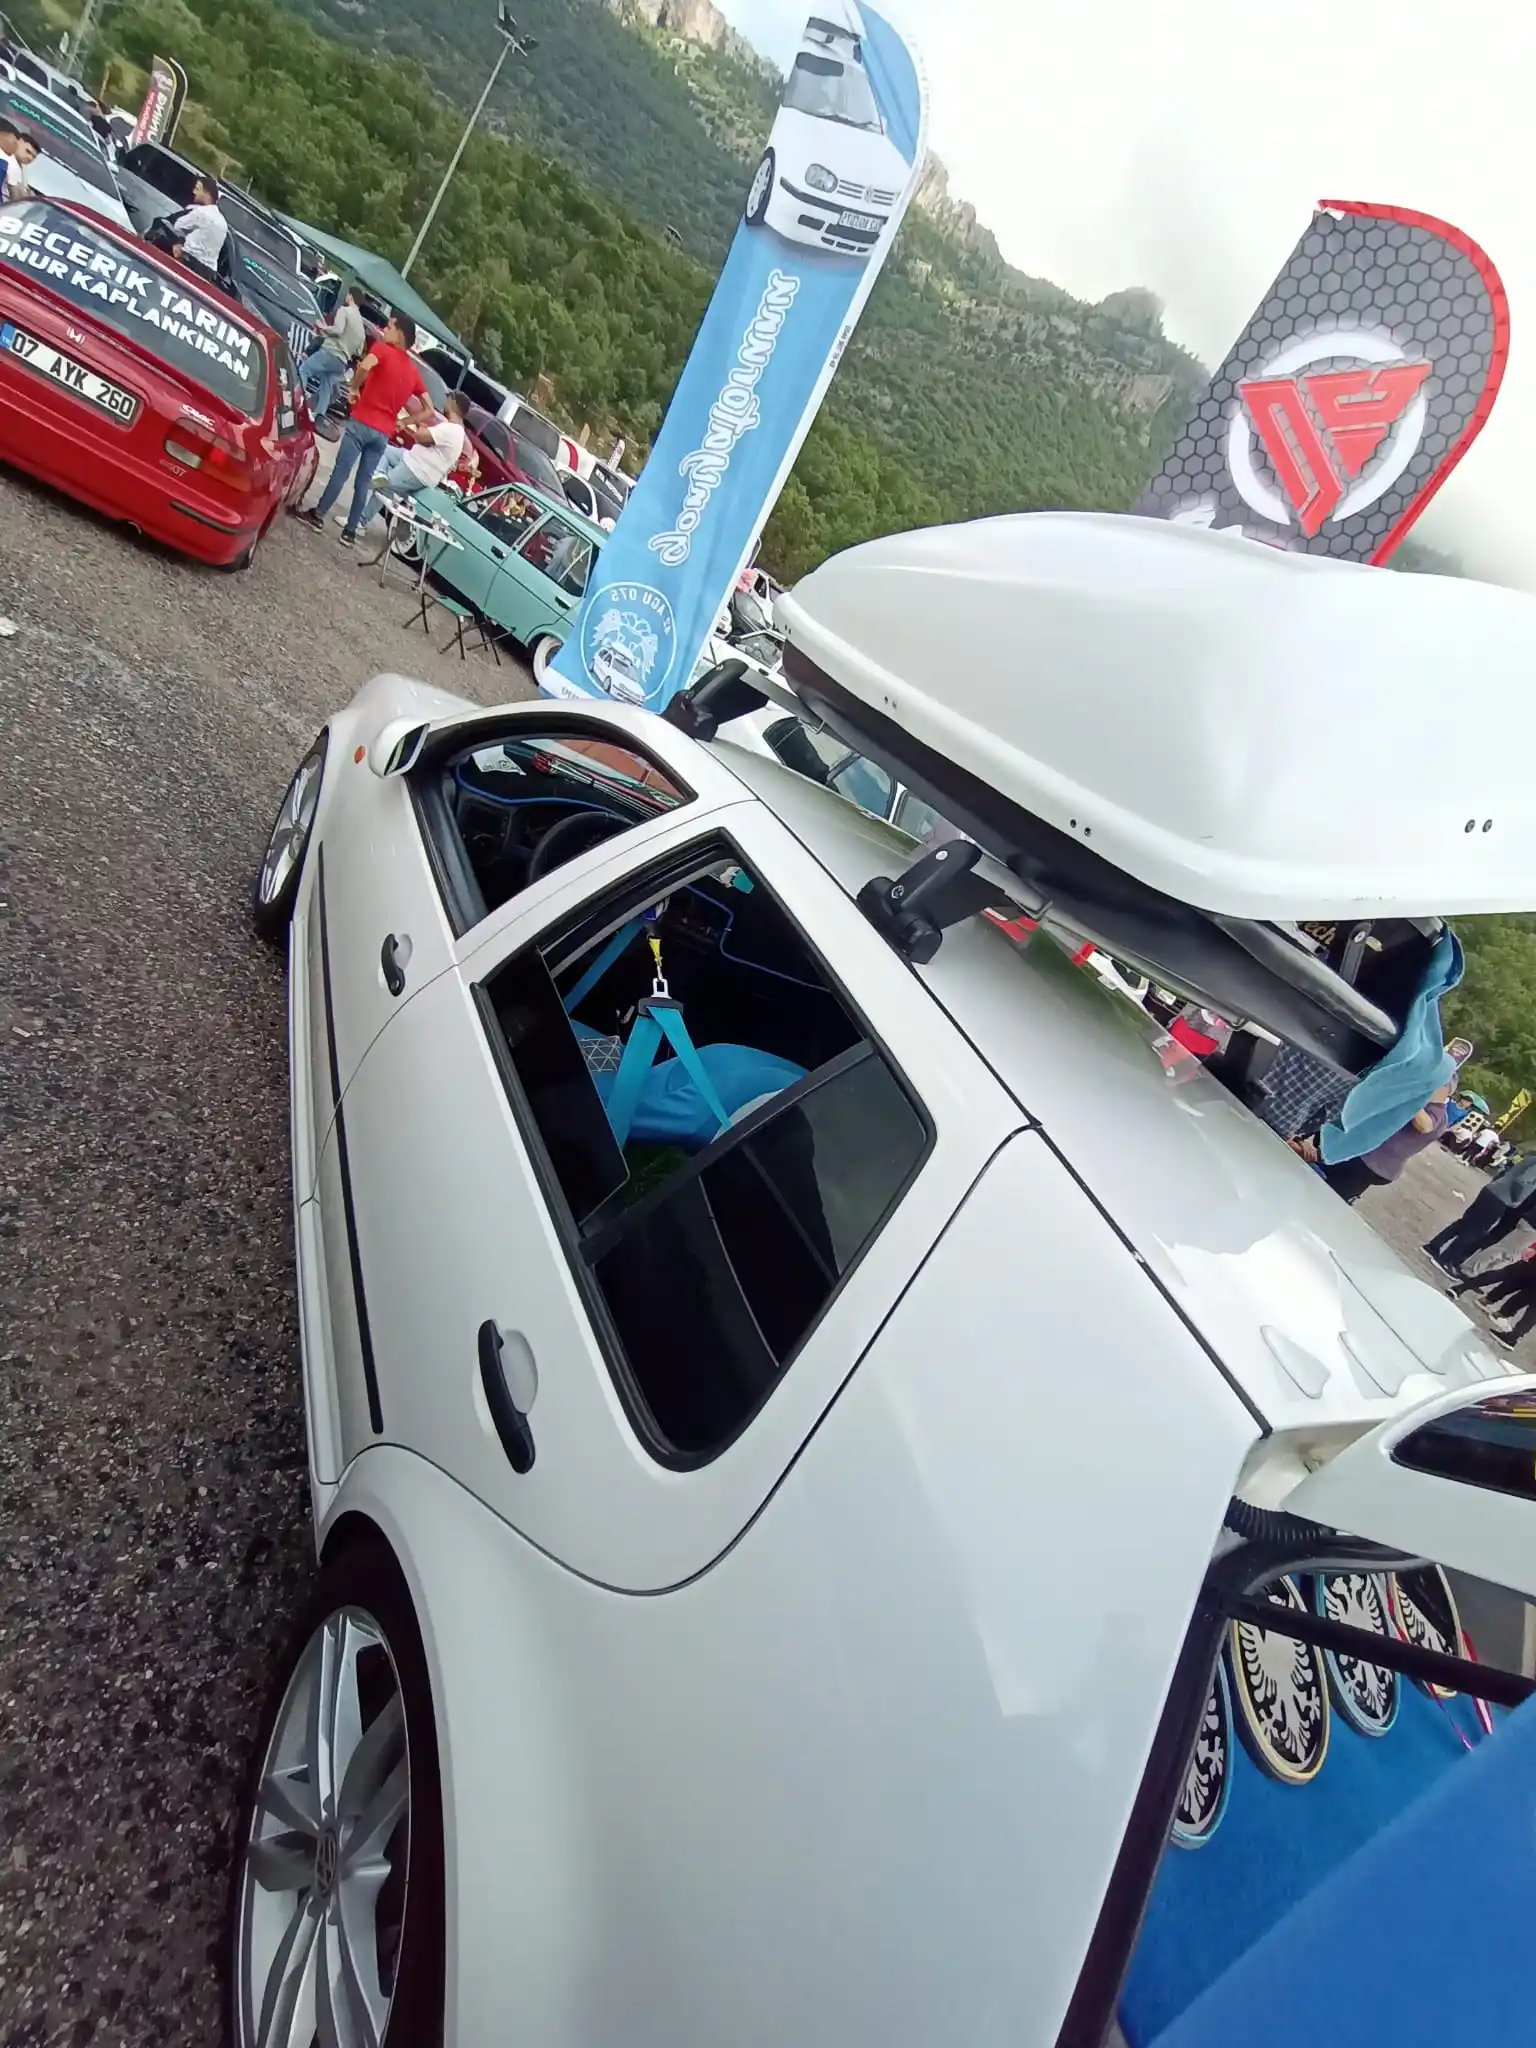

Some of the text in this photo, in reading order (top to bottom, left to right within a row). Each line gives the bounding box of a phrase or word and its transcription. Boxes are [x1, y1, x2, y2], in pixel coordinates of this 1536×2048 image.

[0, 215, 153, 297] BECERIK
[159, 286, 252, 358] TARIM
[71, 269, 251, 382] KAPLANKIRAN
[11, 332, 134, 418] 07 AYK 260
